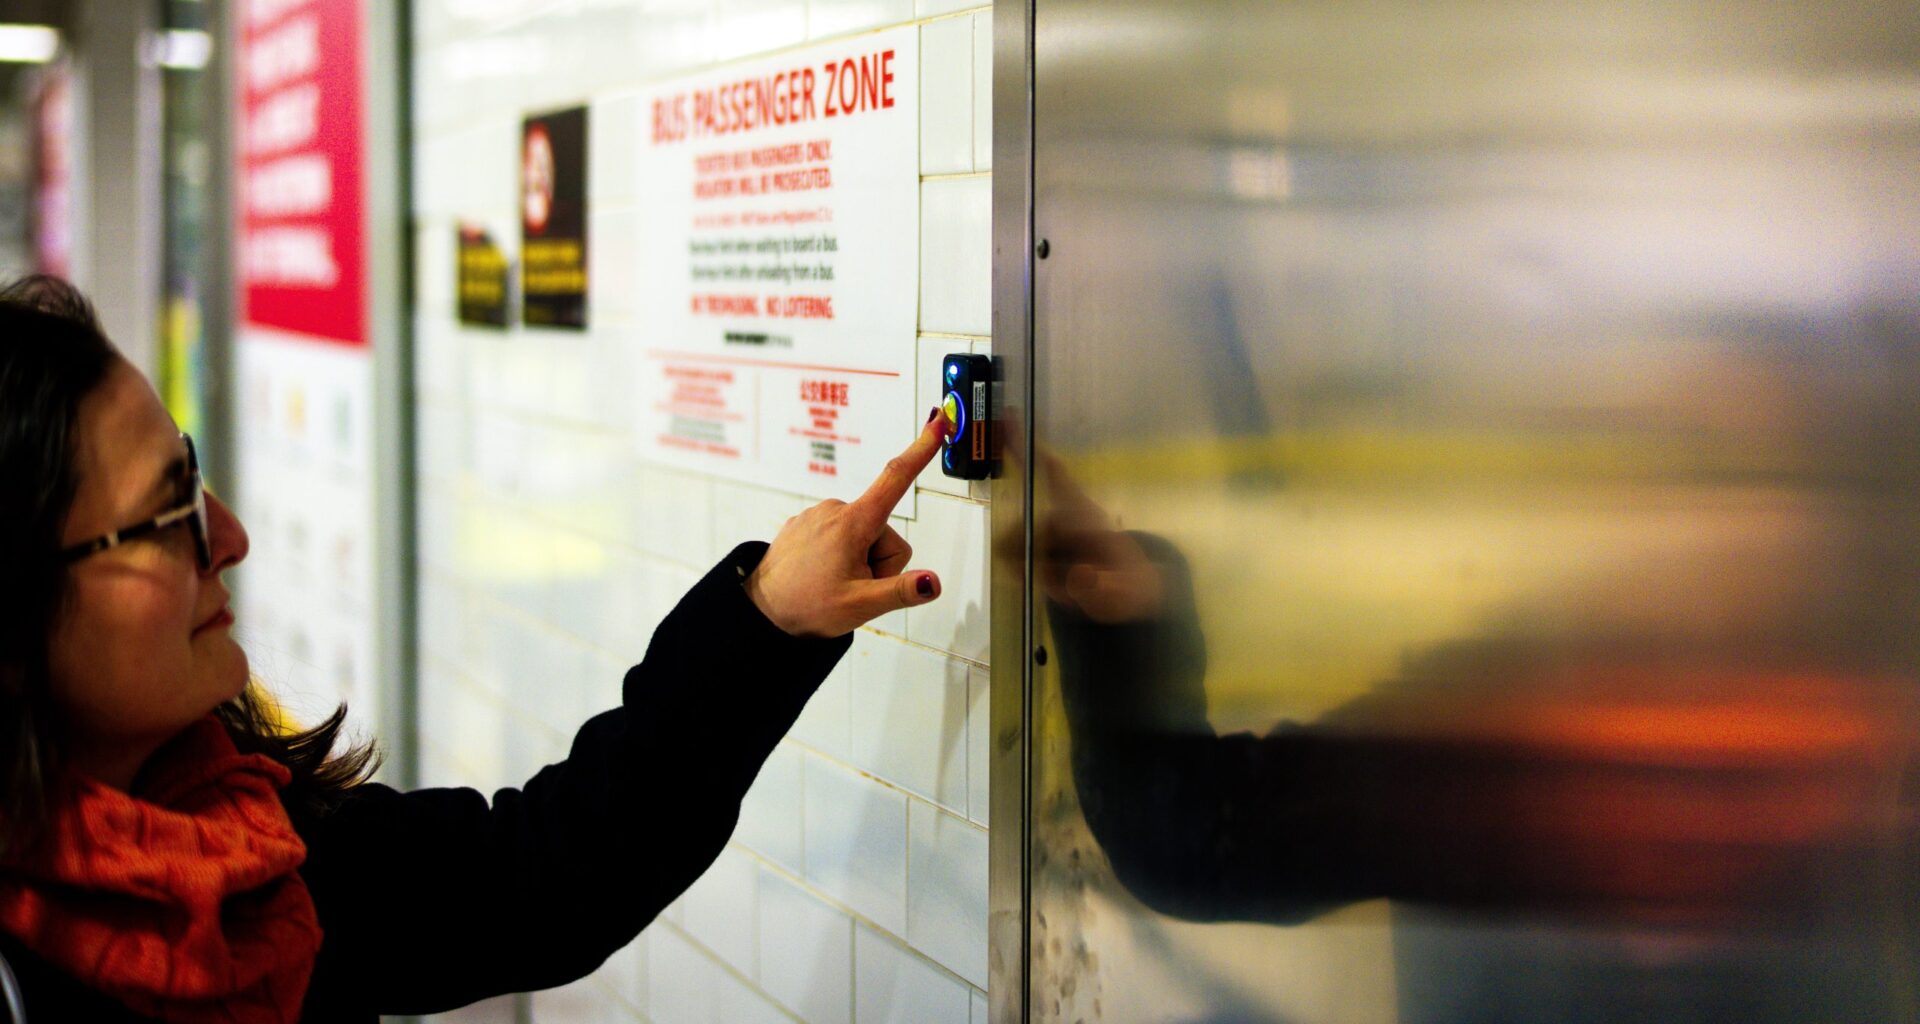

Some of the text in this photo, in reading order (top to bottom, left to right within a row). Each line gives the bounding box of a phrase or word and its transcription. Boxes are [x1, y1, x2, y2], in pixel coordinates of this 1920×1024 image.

[652, 50, 895, 145] BUS PASSENGER ZONE
[793, 234, 814, 252] board
[793, 261, 811, 280] from
